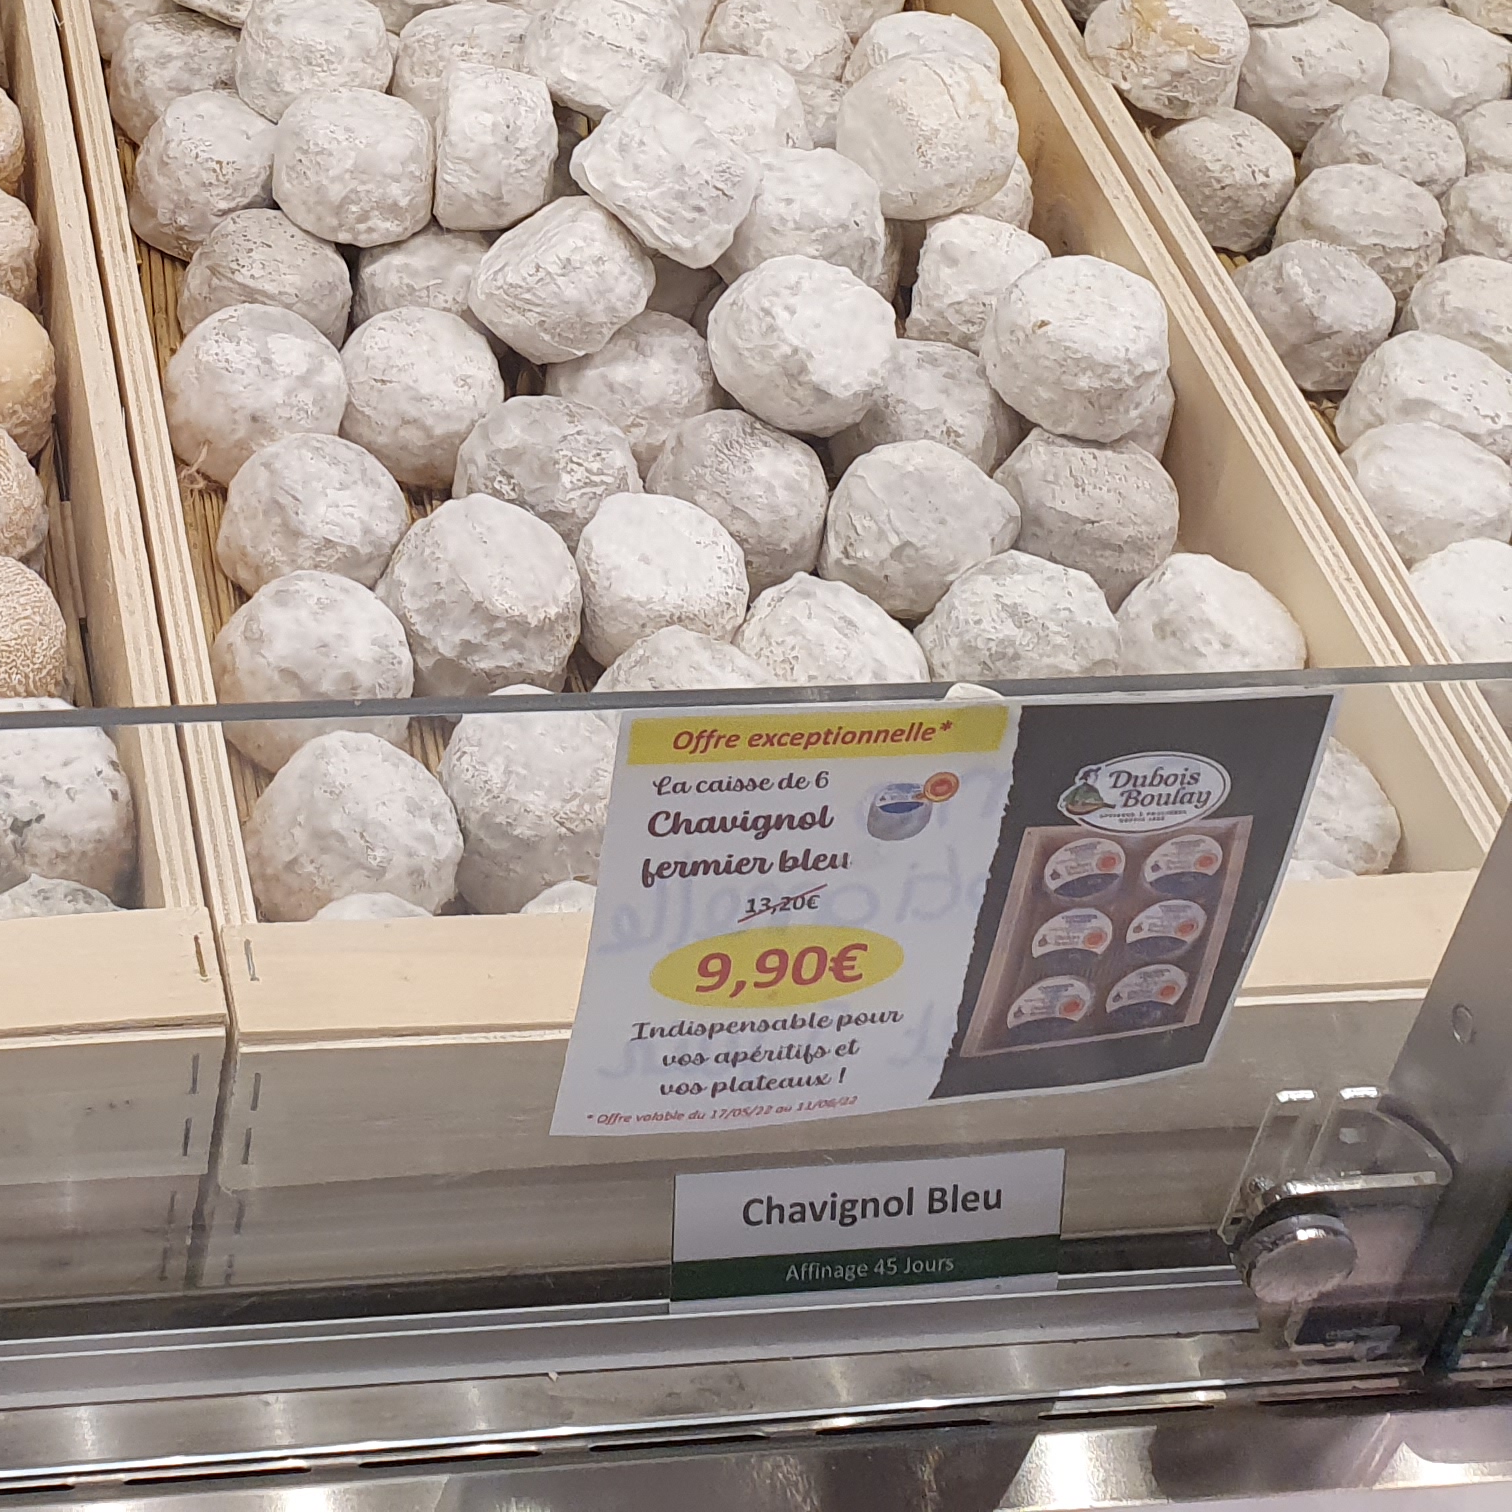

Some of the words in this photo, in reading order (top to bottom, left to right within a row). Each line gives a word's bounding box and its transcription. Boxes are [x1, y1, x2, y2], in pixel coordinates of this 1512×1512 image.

[672, 729, 740, 755] Offre
[652, 775, 692, 797] La
[696, 773, 774, 795] caisse
[778, 772, 810, 790] de
[815, 770, 829, 789] 6
[1109, 766, 1201, 789] Dubois
[1120, 788, 1212, 809] Boulay
[647, 804, 835, 840] Chavignol
[641, 854, 774, 888] fermier
[778, 848, 851, 872] bleu
[744, 894, 821, 915] 13,20€
[695, 942, 868, 999] 9,90€
[630, 1012, 833, 1042] Indispensable
[835, 1010, 904, 1032] pour
[661, 1052, 709, 1068] vos
[713, 1041, 831, 1068] apéritifs
[834, 1038, 861, 1057] et
[660, 1081, 708, 1097] vos
[710, 1074, 833, 1098] plateaux
[838, 1067, 847, 1085] !
[597, 1113, 631, 1126] Offre
[636, 1110, 685, 1122] valable
[688, 1110, 705, 1121] du
[775, 1104, 793, 1115] au
[742, 1186, 914, 1227] Chavignol
[927, 1184, 1002, 1215] Bleu
[786, 1259, 868, 1282] Affinage
[873, 1258, 898, 1275] 45
[904, 1256, 954, 1274] Jours
